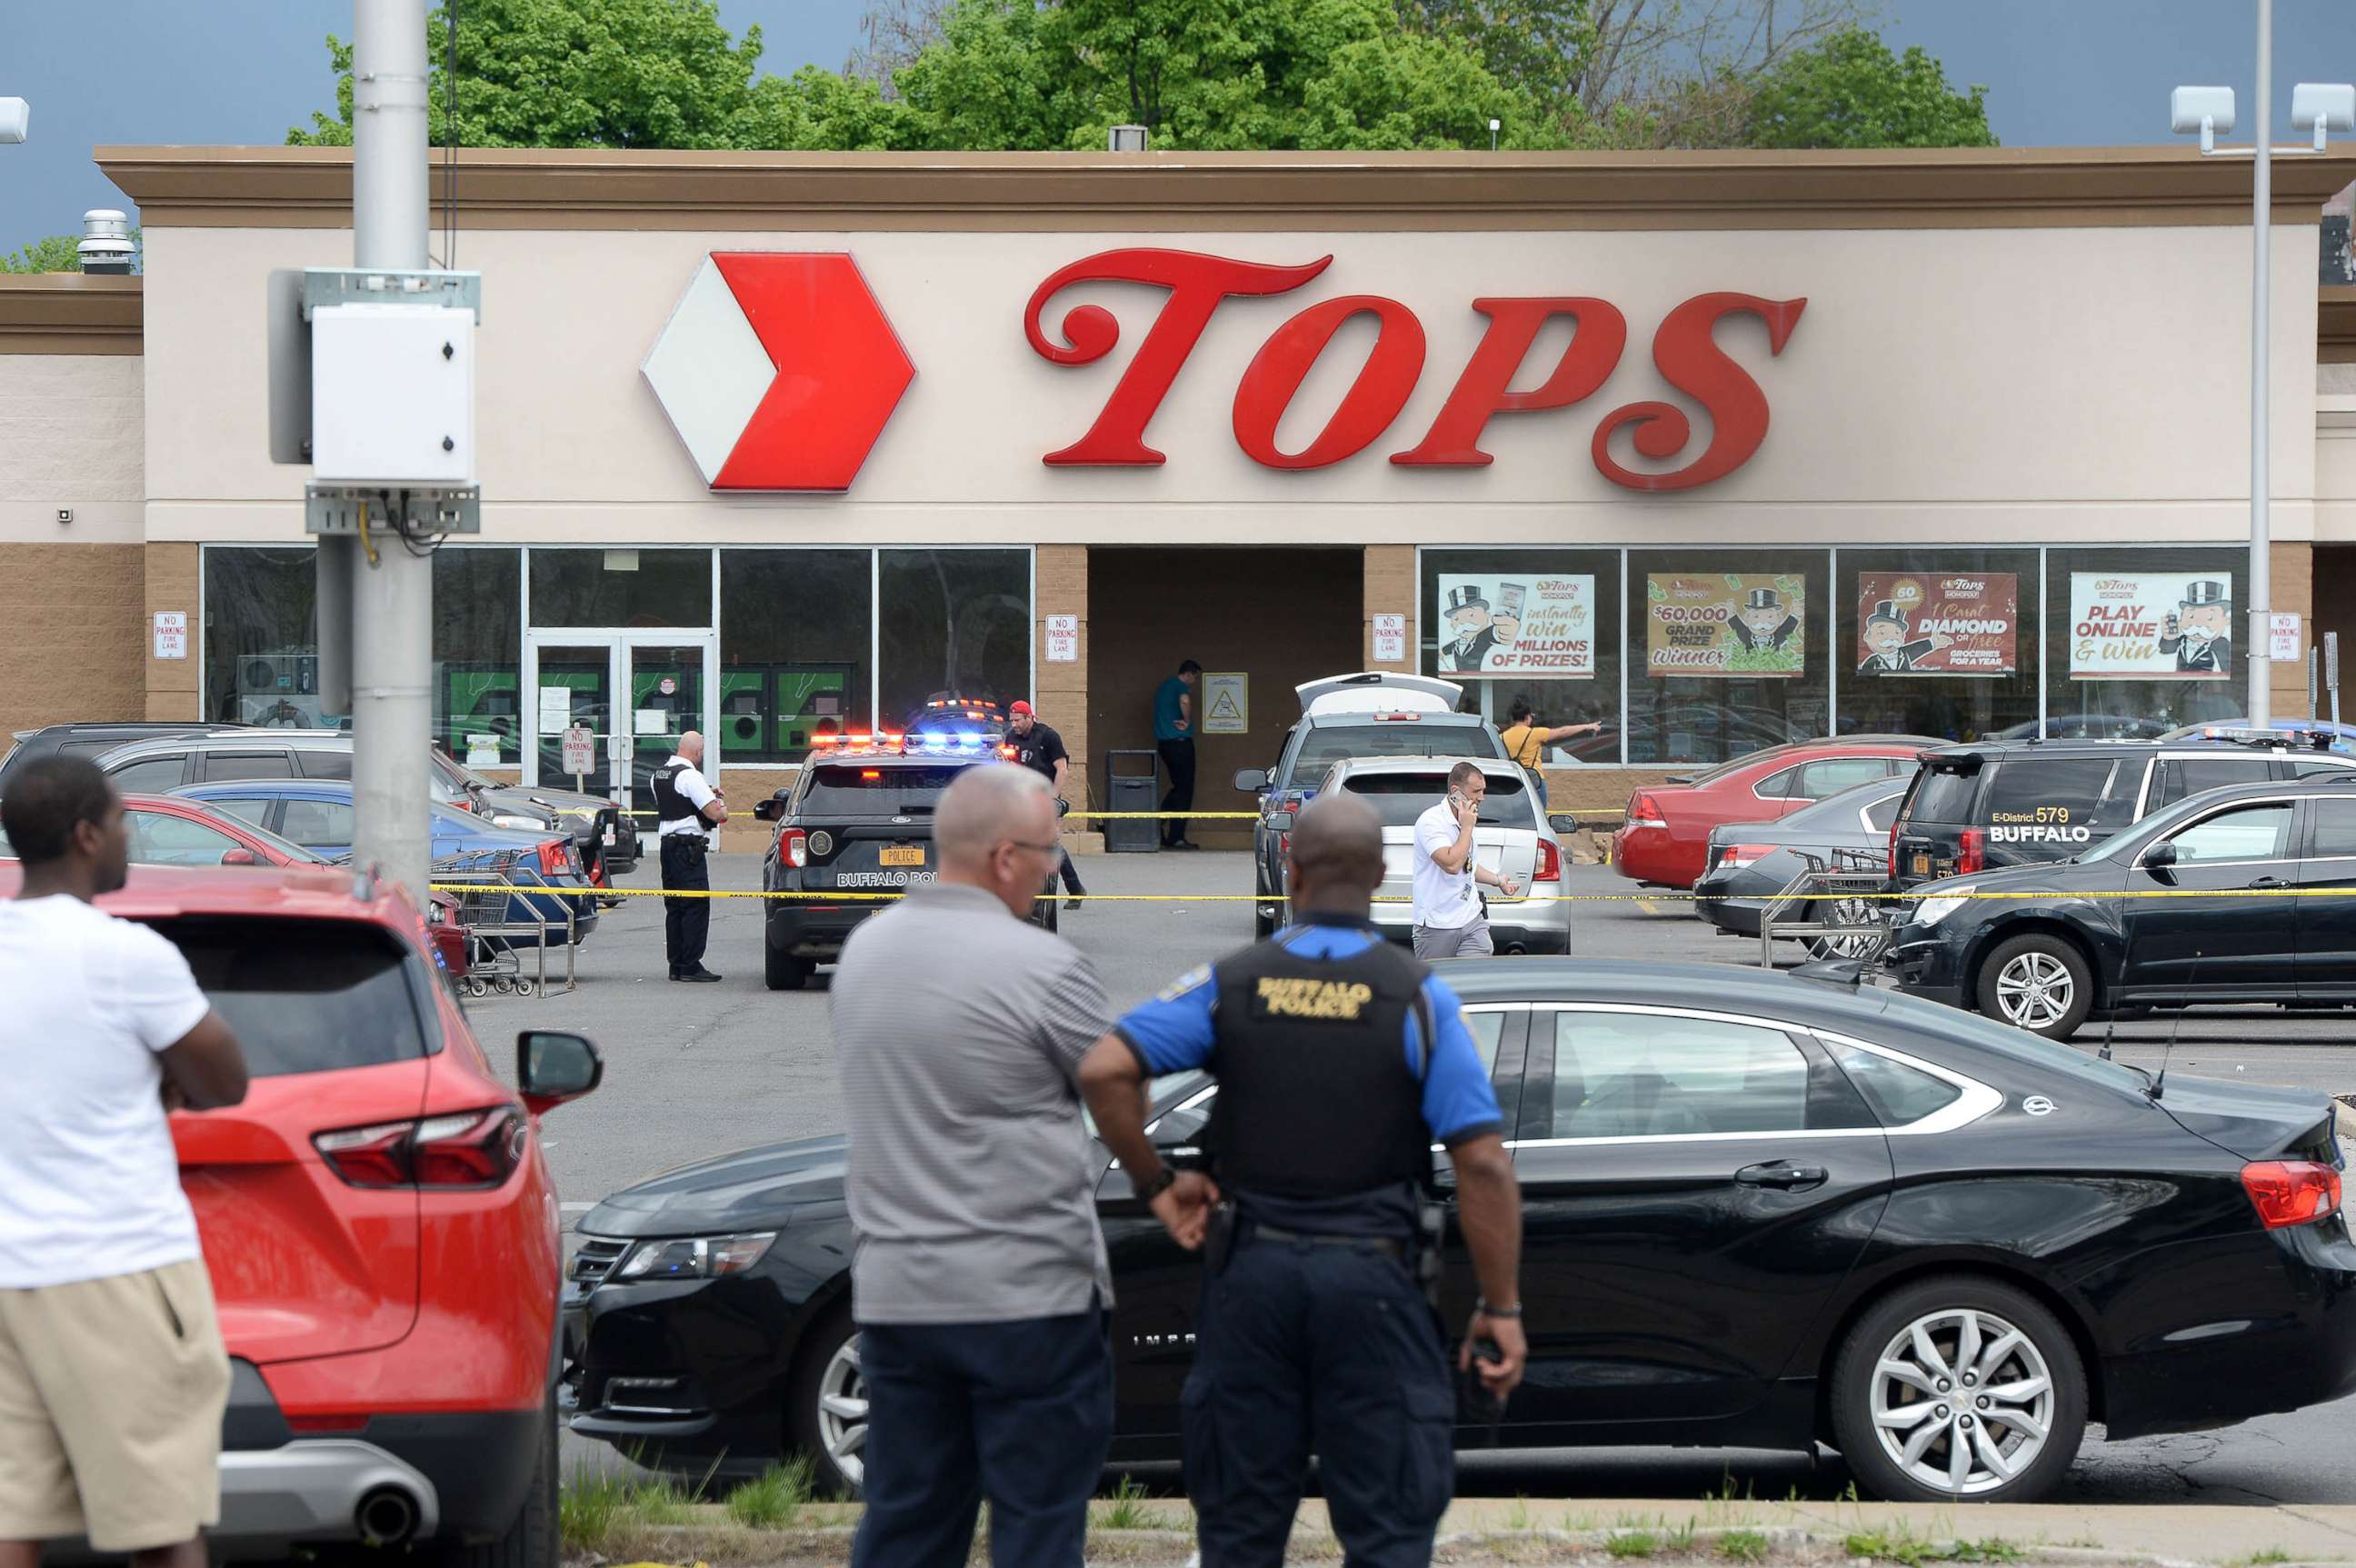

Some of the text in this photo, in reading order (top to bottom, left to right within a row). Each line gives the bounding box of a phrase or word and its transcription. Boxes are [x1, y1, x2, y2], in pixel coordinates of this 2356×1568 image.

[1898, 587, 1915, 597] 60
[1527, 604, 1586, 626] instantly
[1654, 605, 1727, 623] $60,000
[2088, 605, 2145, 620] PLAY
[165, 616, 176, 624] NO
[1056, 619, 1068, 628] NO
[1383, 618, 1394, 627] NO
[2279, 618, 2291, 626] NO
[156, 626, 185, 635] PARKING
[1665, 625, 1715, 635] GRAND
[1919, 619, 2007, 634] DIAMOND
[2076, 623, 2157, 637] ONLINE
[1048, 630, 1075, 638] PARKING
[1375, 629, 1403, 637] PARKING
[1513, 640, 1588, 652] MILLIONS
[1669, 636, 1711, 646] PRIZE
[1968, 633, 2005, 650] free
[2075, 640, 2095, 664] &
[1492, 654, 1588, 666] OF PRIZES!
[1977, 657, 2002, 665] YEAR
[572, 733, 583, 742] NO
[564, 742, 591, 752] PARKING
[1992, 807, 2069, 823] E-District 579
[1989, 826, 2090, 843] BUFFALO
[888, 850, 916, 862] POLICE
[837, 872, 907, 887] BUFFALO
[1257, 977, 1373, 1004] BUFFALO
[1266, 996, 1360, 1019] POLICE
